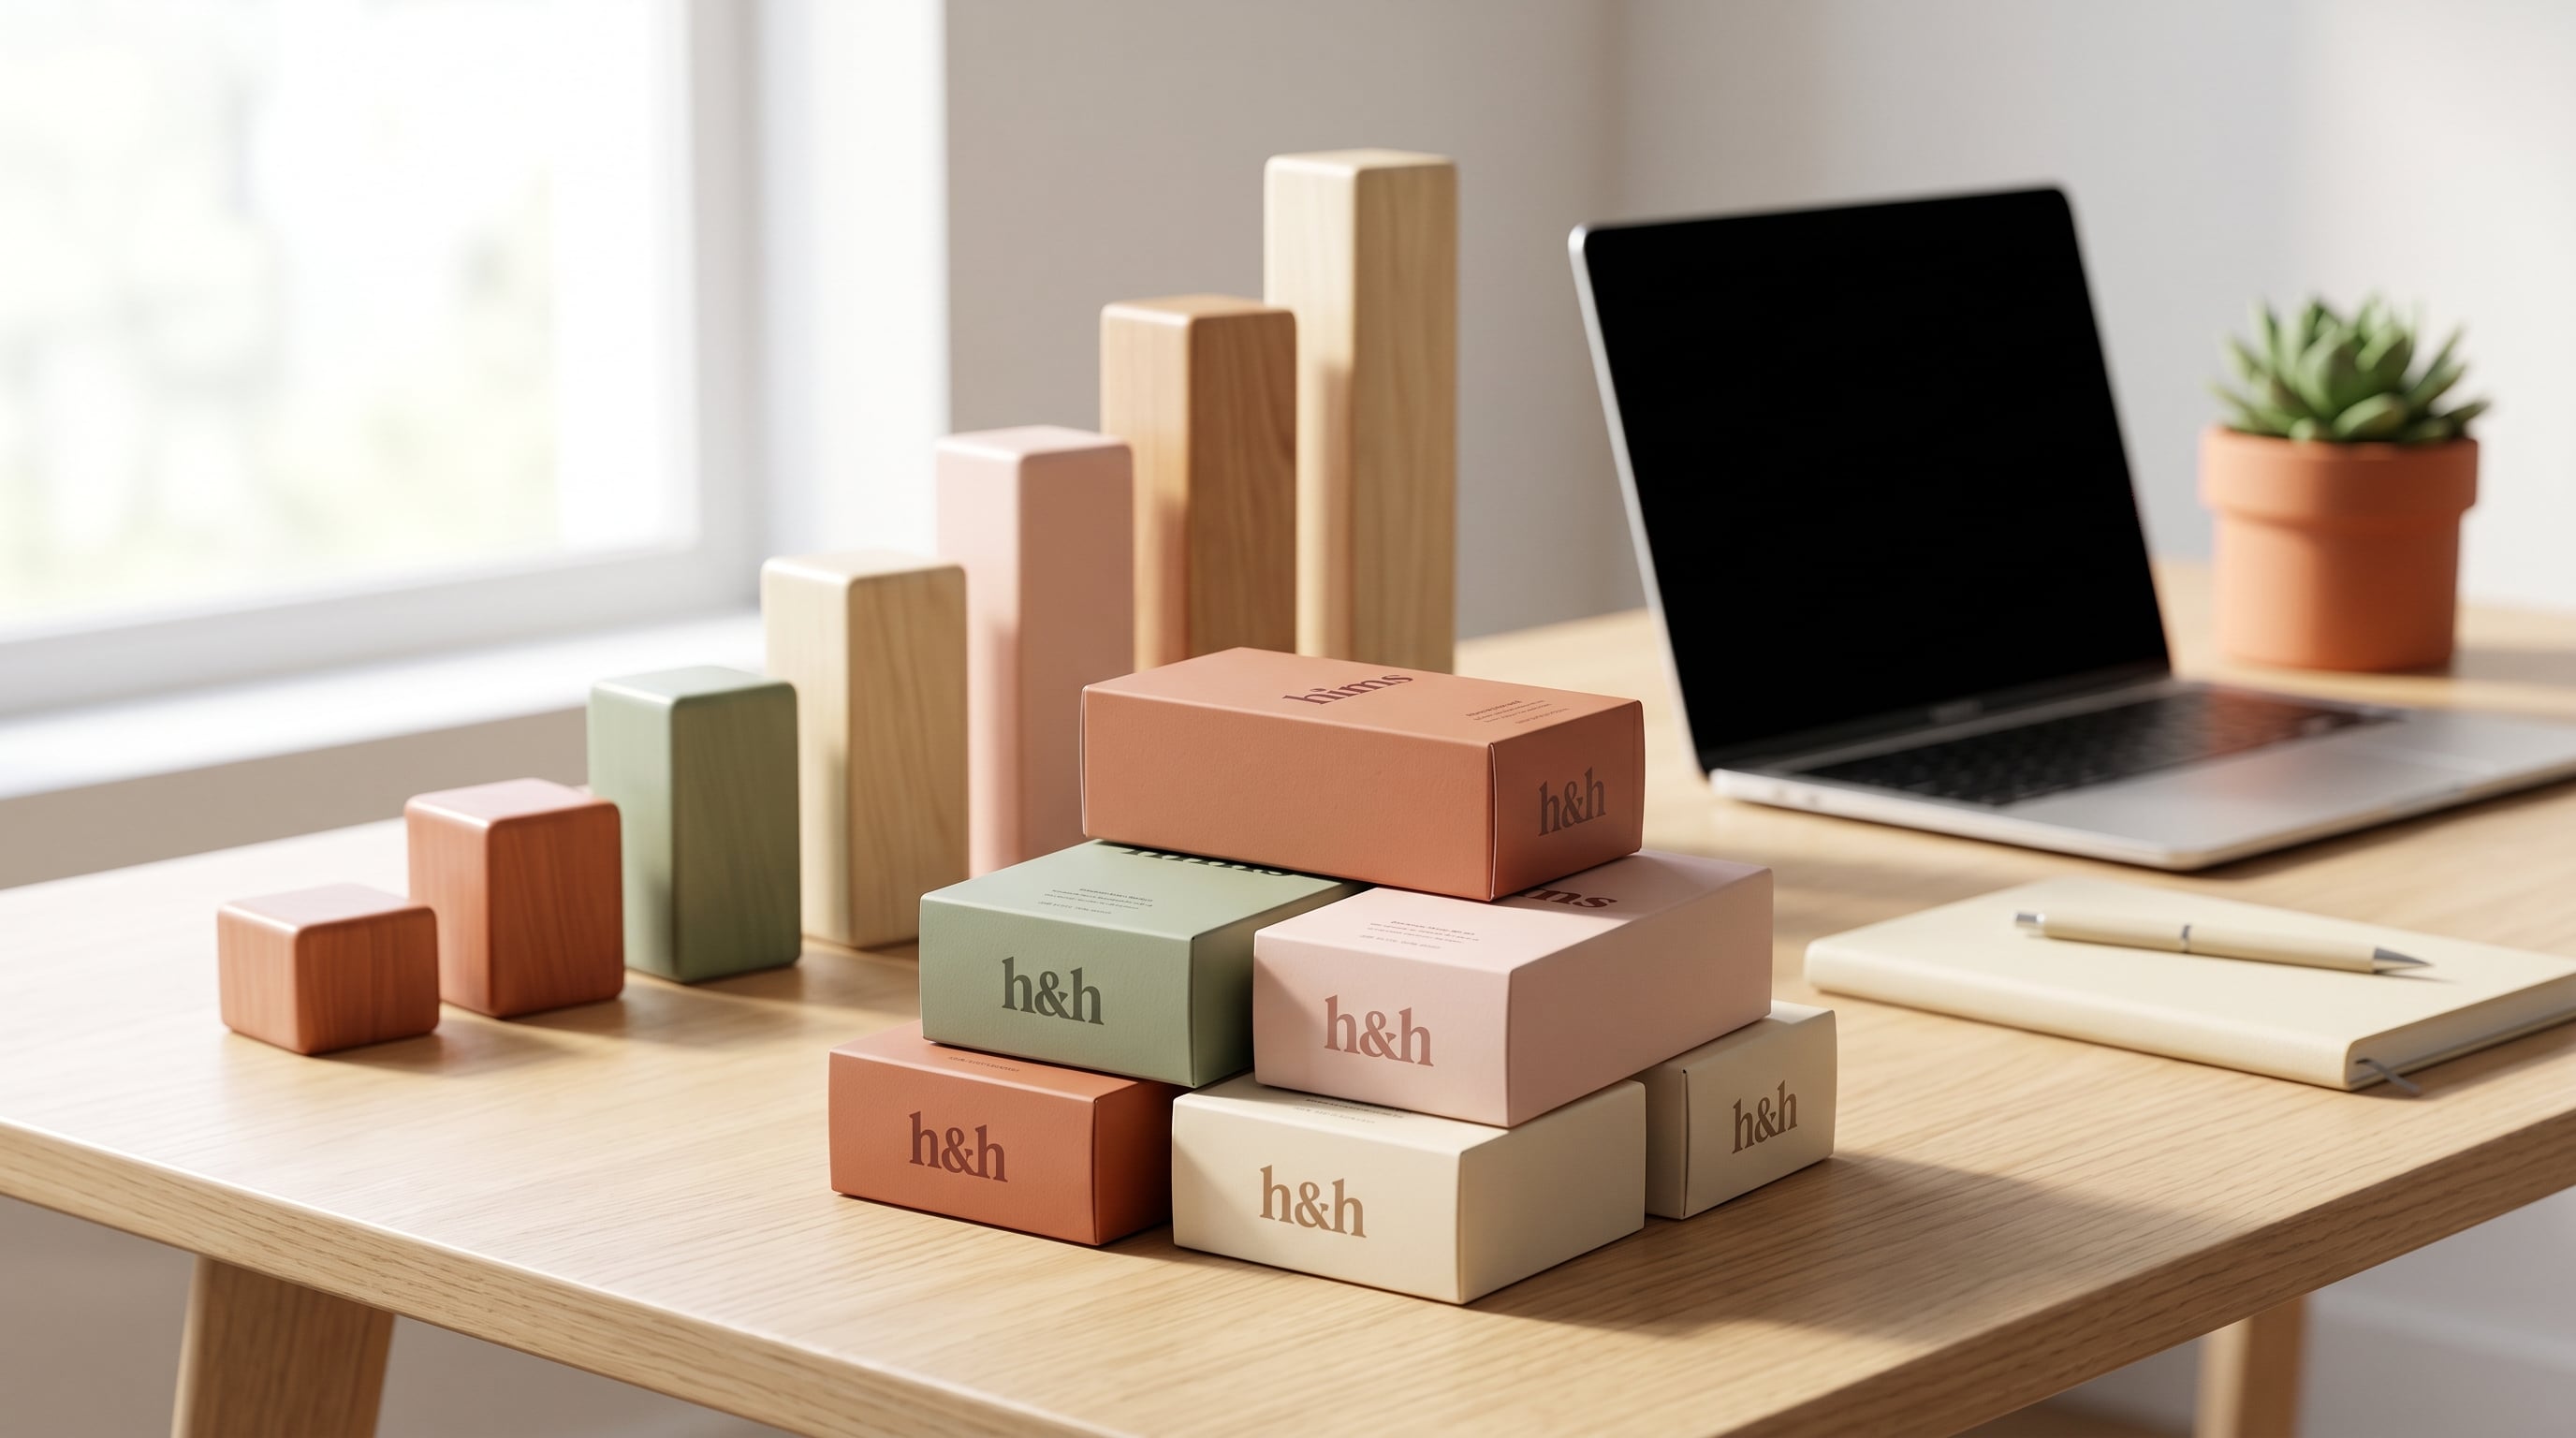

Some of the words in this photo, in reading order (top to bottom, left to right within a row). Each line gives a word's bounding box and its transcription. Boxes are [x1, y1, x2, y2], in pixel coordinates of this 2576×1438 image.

[1281, 674, 1413, 705] hims
[1538, 766, 1606, 837] h&h
[1515, 888, 1618, 908] ms
[1001, 956, 1105, 1026] h&h
[1324, 994, 1435, 1067] h&h
[909, 1110, 1009, 1183] h&h
[1732, 1080, 1798, 1154] h&h
[1259, 1165, 1367, 1239] h&h
